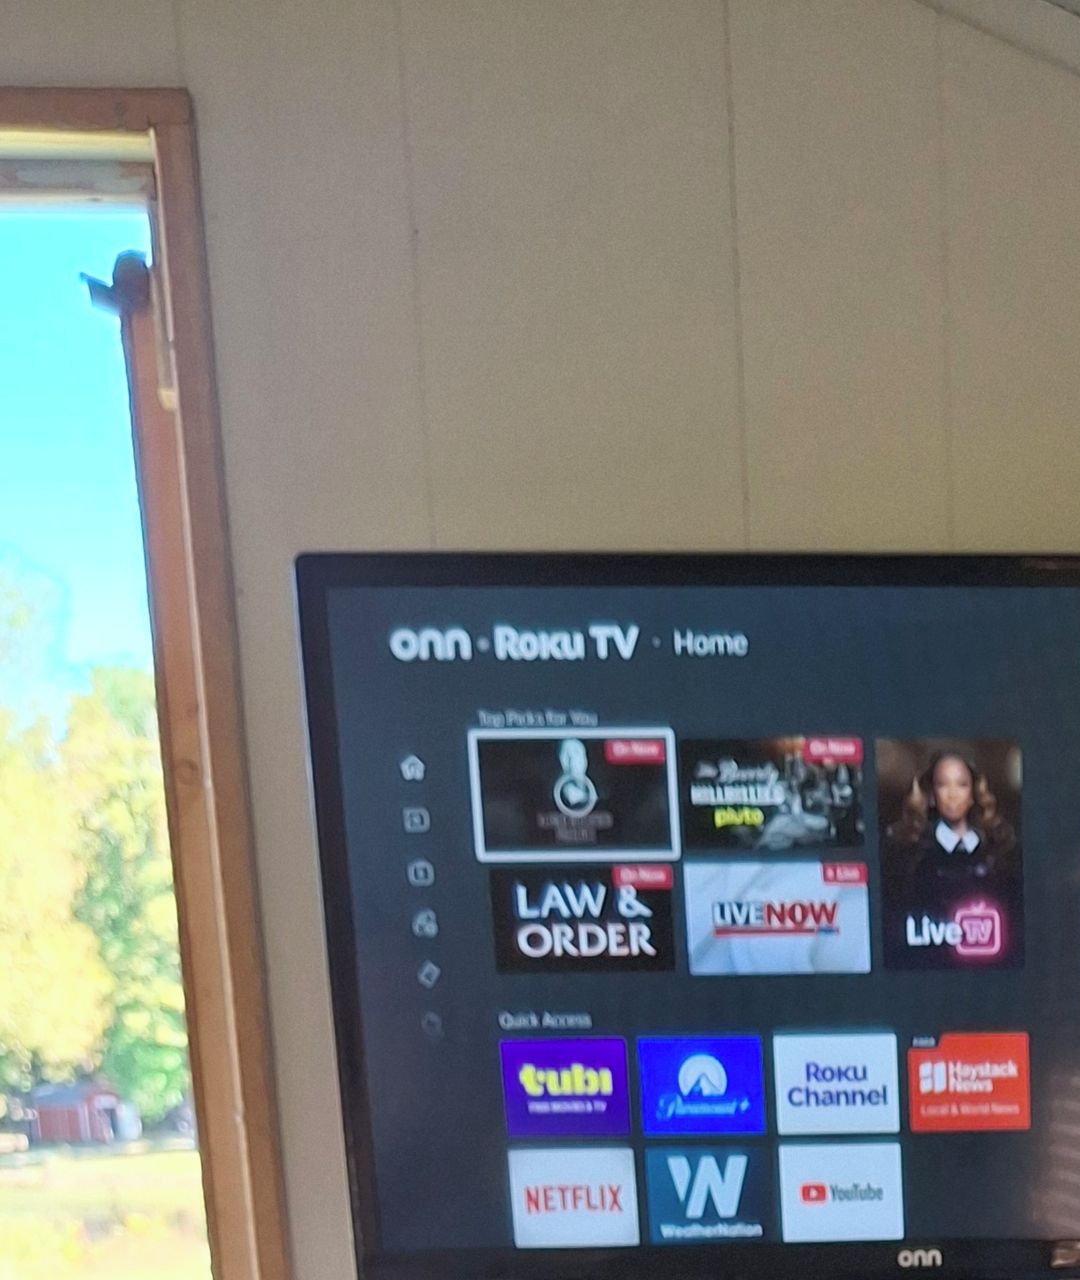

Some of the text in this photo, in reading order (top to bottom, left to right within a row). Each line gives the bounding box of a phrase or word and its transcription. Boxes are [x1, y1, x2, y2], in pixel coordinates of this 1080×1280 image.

[389, 624, 749, 662] onn Roku TV Home
[478, 709, 599, 728] Top Picks for You
[514, 881, 654, 919] LAW &
[516, 922, 657, 958] ORDER
[499, 1012, 592, 1029] Quick Access
[519, 1063, 613, 1096] tubi
[805, 1062, 867, 1083] Roku
[948, 1060, 1018, 1081] Haystack
[788, 1086, 889, 1108] Channel
[948, 1079, 993, 1094] News
[524, 1183, 623, 1213] NETFLIX
[829, 1184, 884, 1202] YouTube
[660, 1222, 763, 1239] WeatherNation
[897, 1248, 942, 1268] onn
